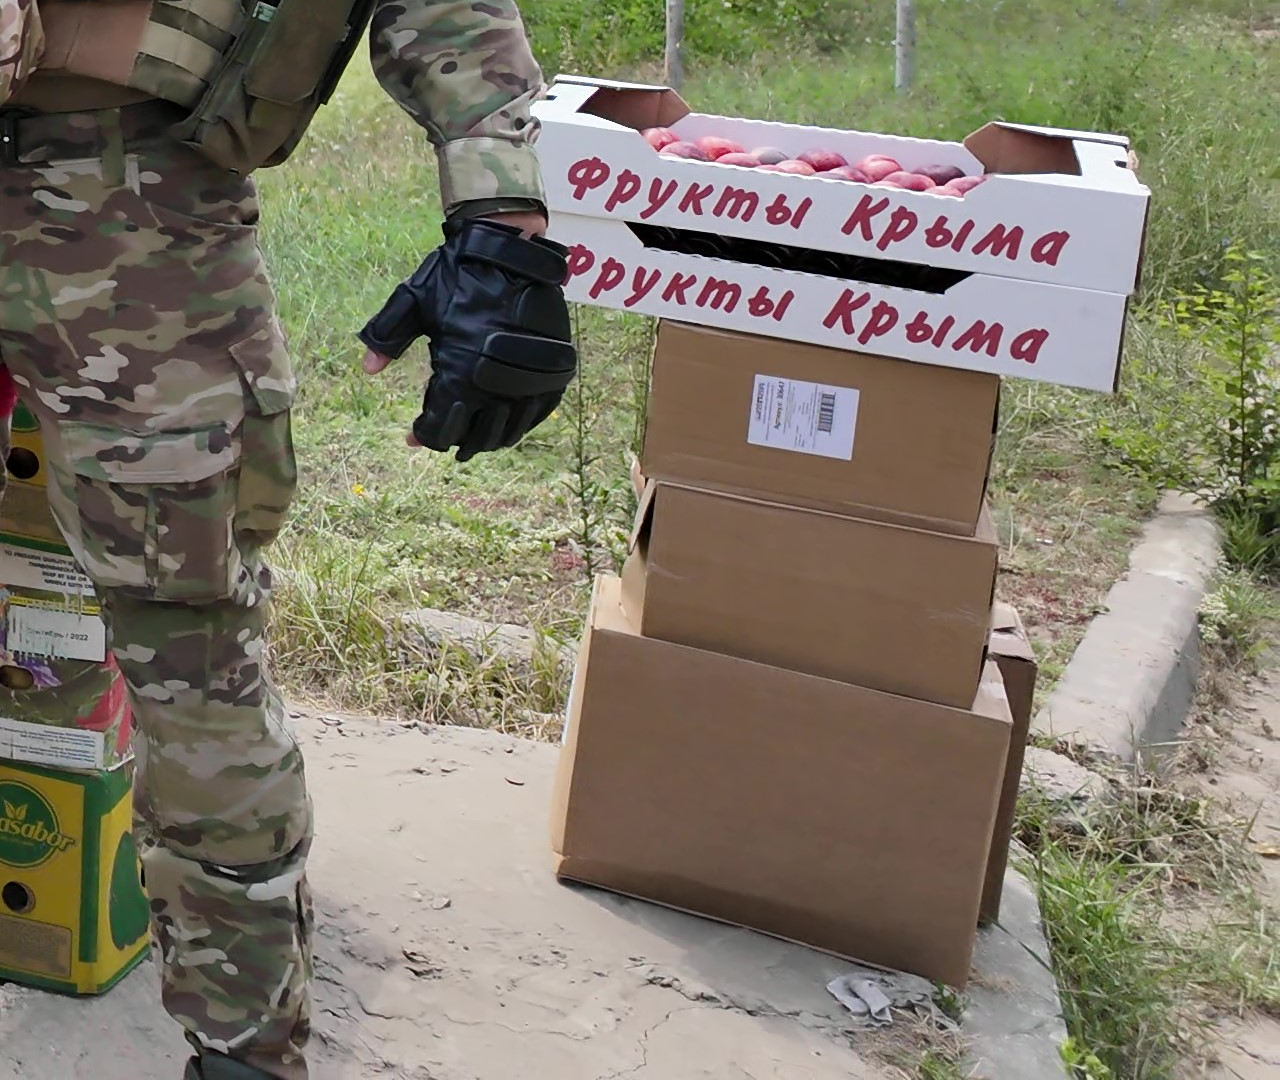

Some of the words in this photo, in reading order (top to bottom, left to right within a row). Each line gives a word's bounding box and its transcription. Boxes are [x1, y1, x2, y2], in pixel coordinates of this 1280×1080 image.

[567, 155, 814, 230] Фрукты
[840, 193, 1071, 268] Крыма
[823, 288, 1051, 366] Крыма
[70, 633, 89, 641] 2022
